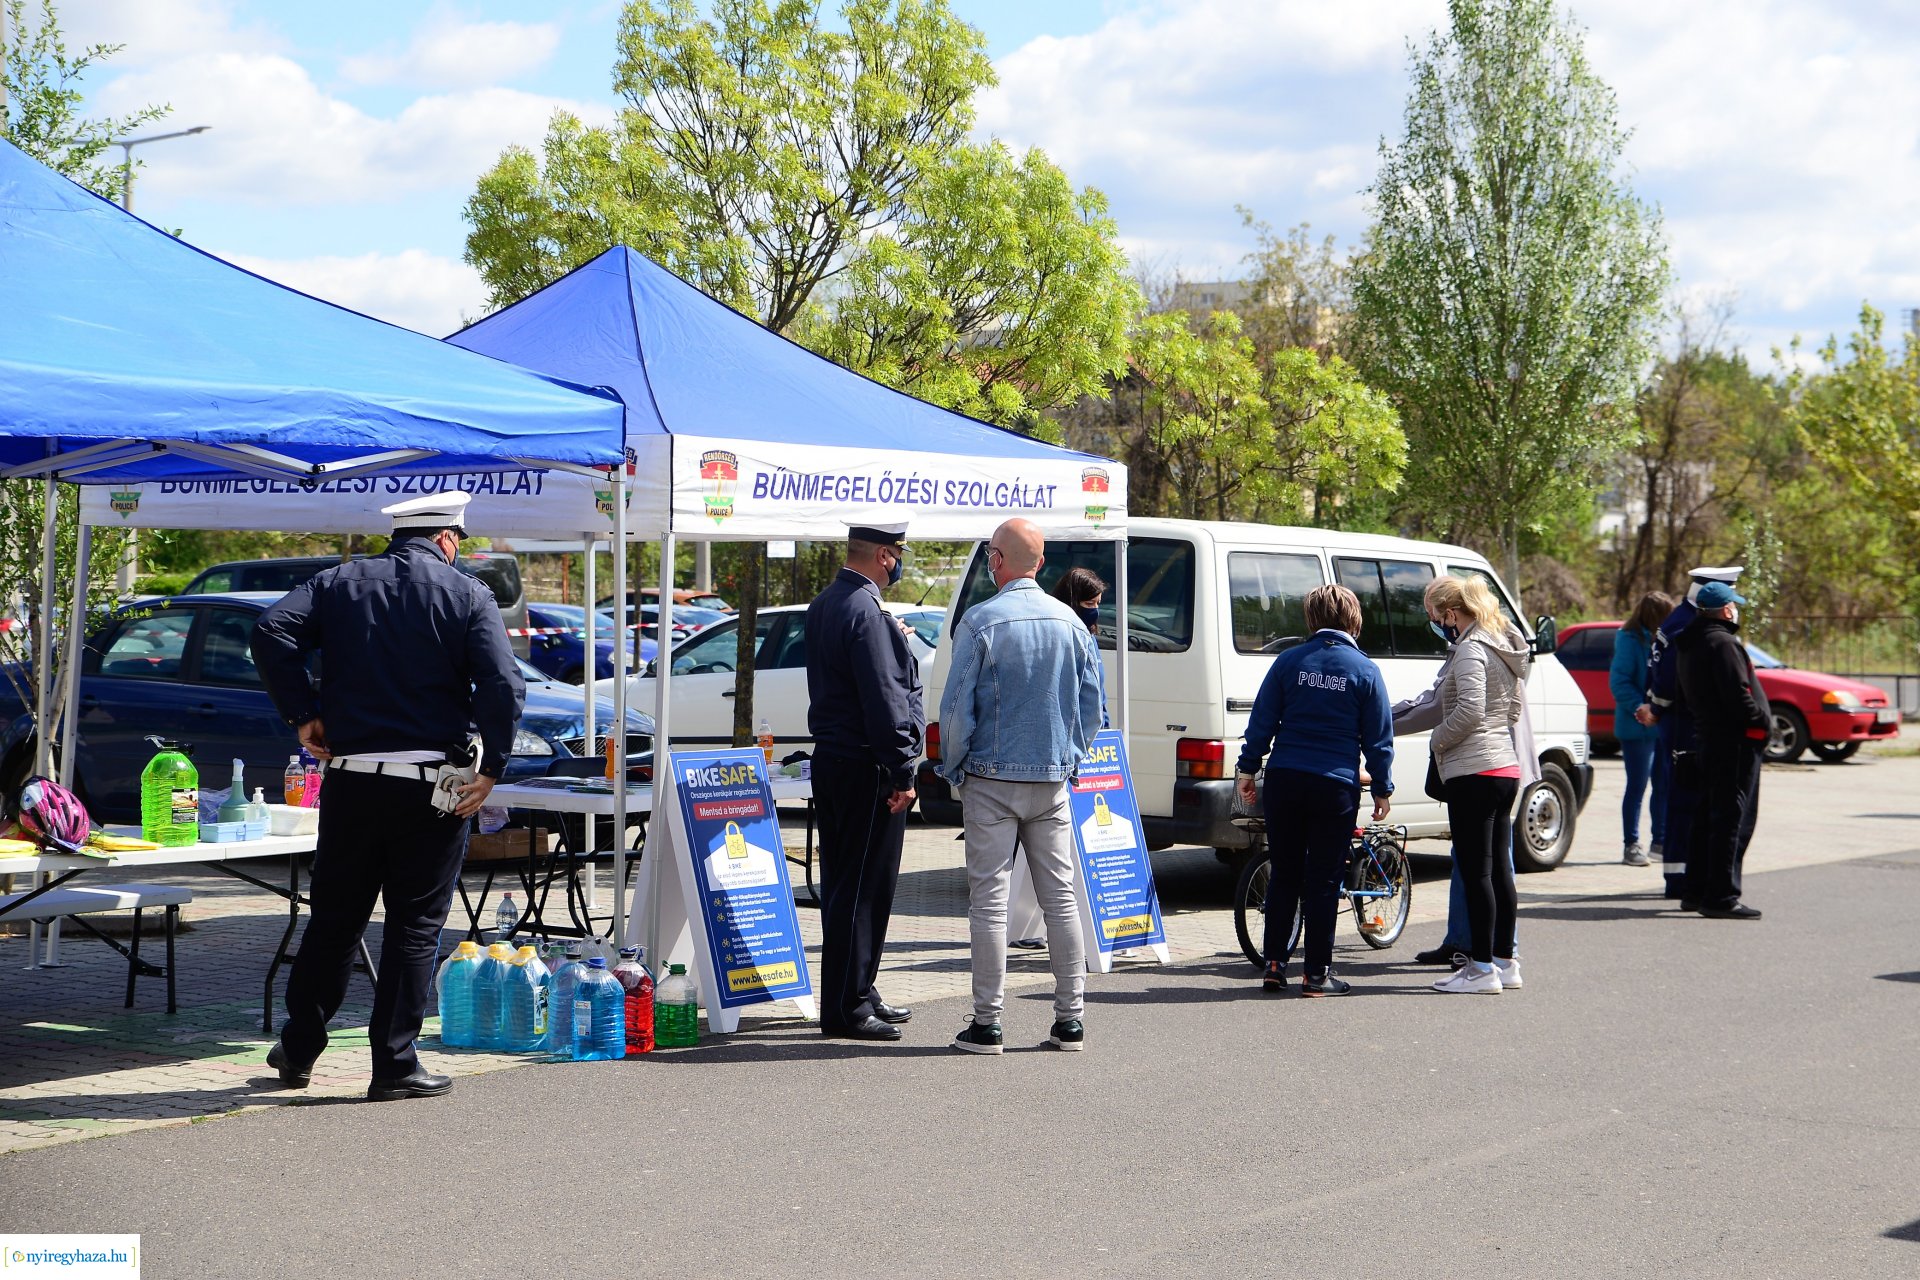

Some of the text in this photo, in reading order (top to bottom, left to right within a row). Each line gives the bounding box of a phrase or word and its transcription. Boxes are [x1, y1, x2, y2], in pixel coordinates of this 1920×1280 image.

[752, 466, 1057, 508] BŰNMEGELŐZÉSI SZOLGÁLAT
[115, 502, 134, 510] POLICE
[601, 503, 614, 511] POL
[710, 507, 729, 516] POLICE
[1298, 671, 1347, 692] POLICE
[1081, 745, 1118, 764] SAFE
[686, 765, 758, 788] BIKESAFE
[690, 787, 761, 800] Országos kerékpár regisztráció
[699, 806, 722, 816] Mentsd
[728, 803, 759, 816] bringádat!
[1106, 919, 1151, 934] www.bikesafe.hu
[731, 968, 794, 987] www.bikesafe.hu
